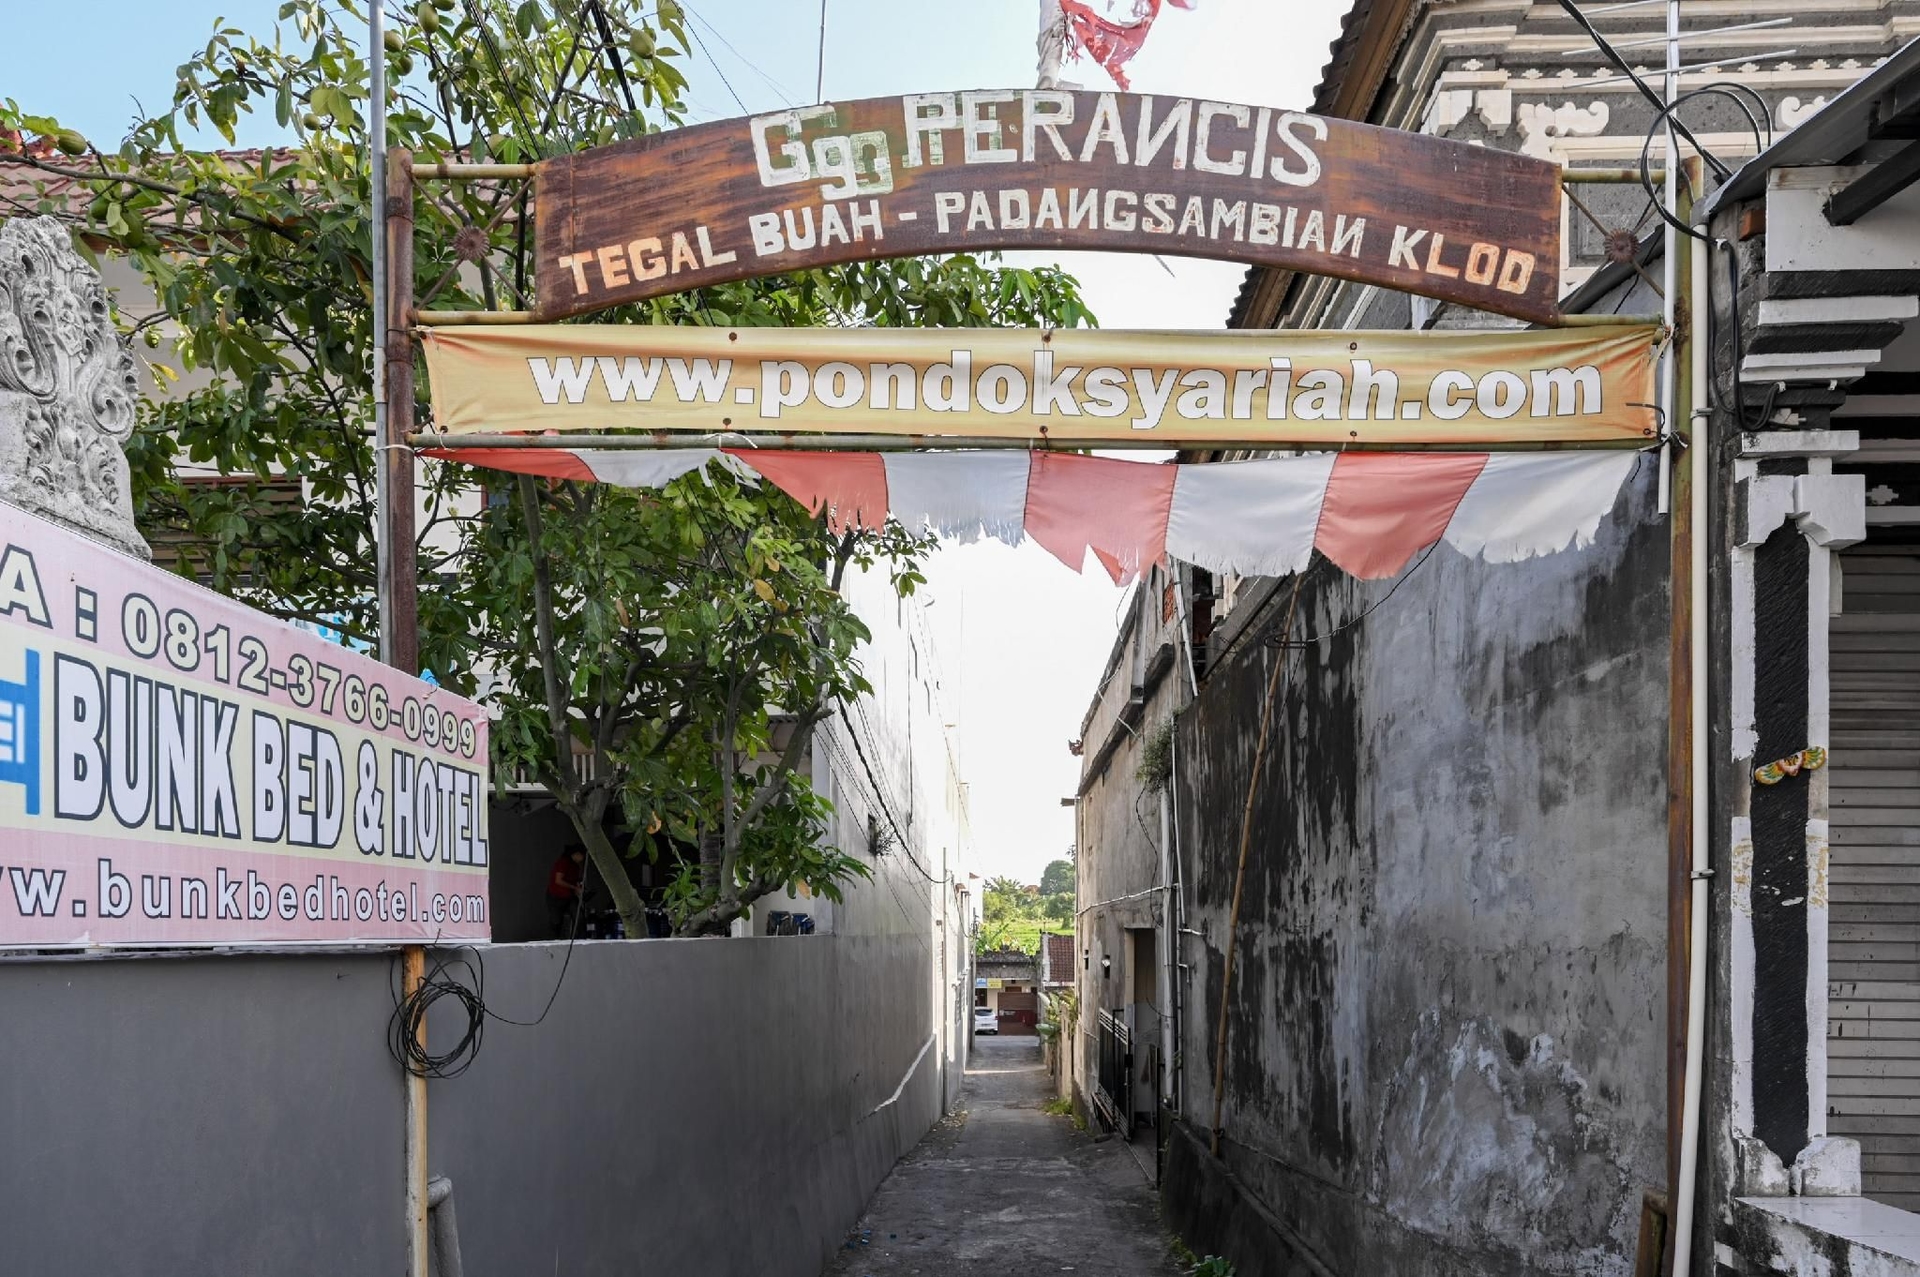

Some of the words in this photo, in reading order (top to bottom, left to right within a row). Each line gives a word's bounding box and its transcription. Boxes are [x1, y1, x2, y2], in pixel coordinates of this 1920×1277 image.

[902, 90, 1328, 187] PERANCIS
[558, 226, 737, 295] TEGAL
[749, 199, 884, 257] BUAH
[935, 188, 1367, 259] PADANGSAMBIAN
[1388, 225, 1537, 295] KLOD
[526, 350, 1601, 430] www.pondoksyariah.com
[121, 592, 476, 759] 0812-3766-0999
[53, 651, 242, 840] BUNK
[251, 709, 345, 849] BED
[354, 738, 384, 857] &
[391, 747, 488, 868] HOTEL
[0, 858, 486, 924] w.bunkbedhotel.com
